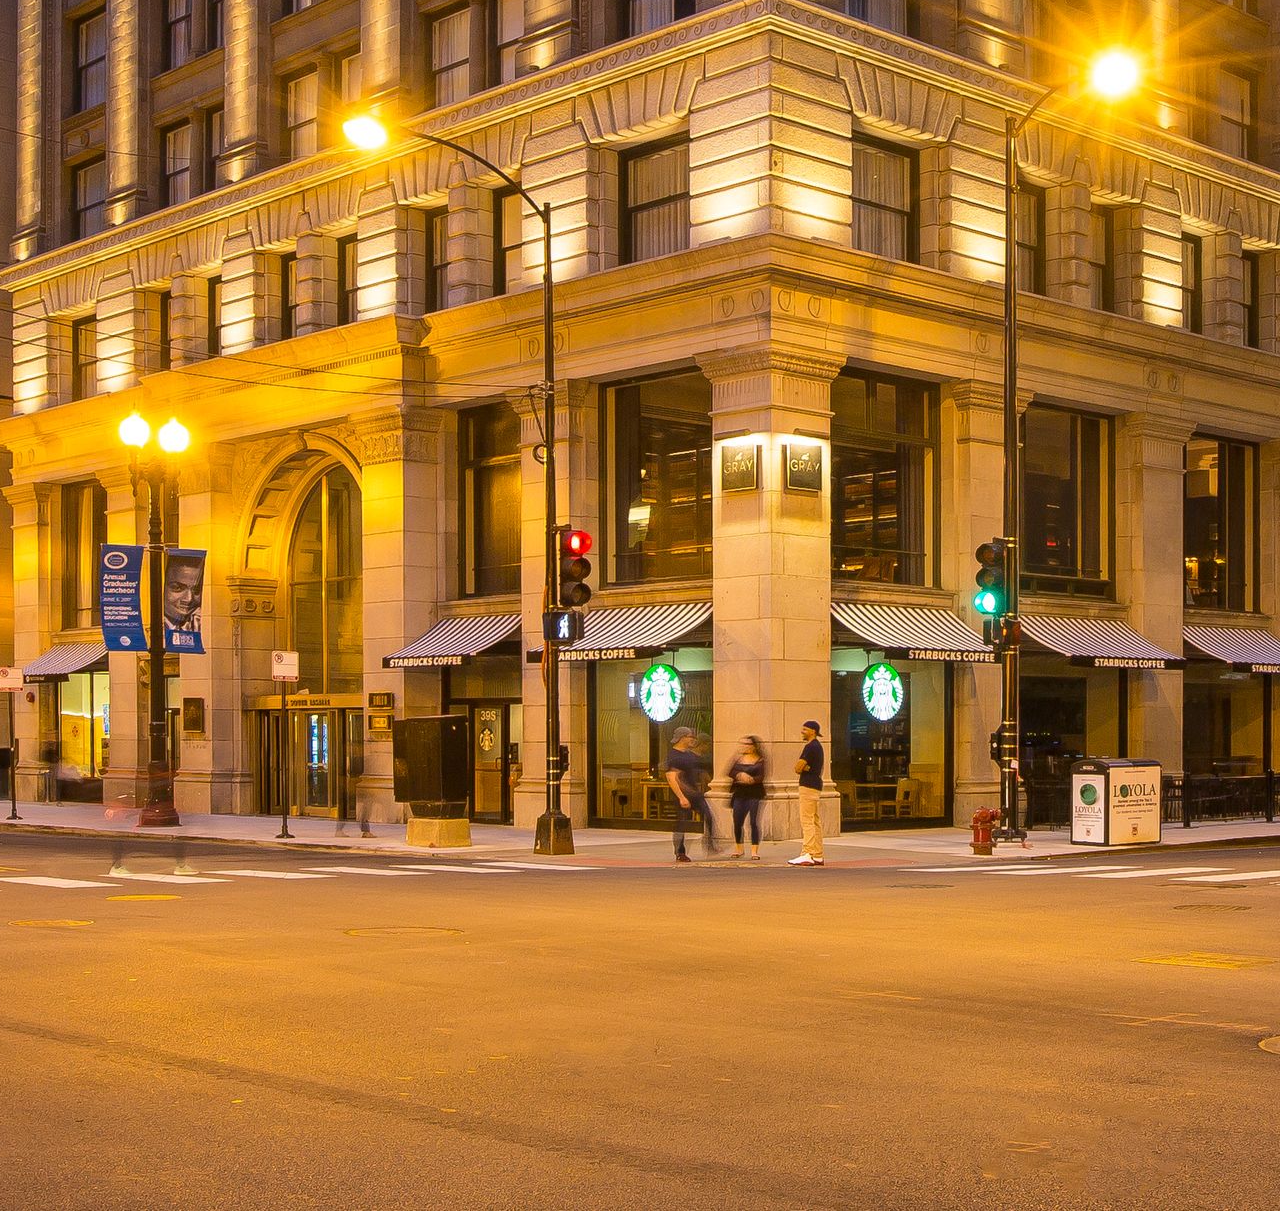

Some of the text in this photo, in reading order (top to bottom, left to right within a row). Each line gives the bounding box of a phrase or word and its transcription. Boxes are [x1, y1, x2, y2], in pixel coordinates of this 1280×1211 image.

[723, 459, 754, 474] GRAY
[790, 459, 820, 473] GRAY
[558, 648, 636, 661] ARBUCKS COFFEE
[908, 649, 995, 662] STARBUCKS COFFEE
[389, 656, 462, 668] STARBUCKS COFFEE
[1094, 658, 1165, 669] STARBUCKS COFFEE
[480, 710, 496, 721] 39S
[1113, 784, 1156, 798] LOYOLA
[1075, 806, 1102, 814] LOYOLA
